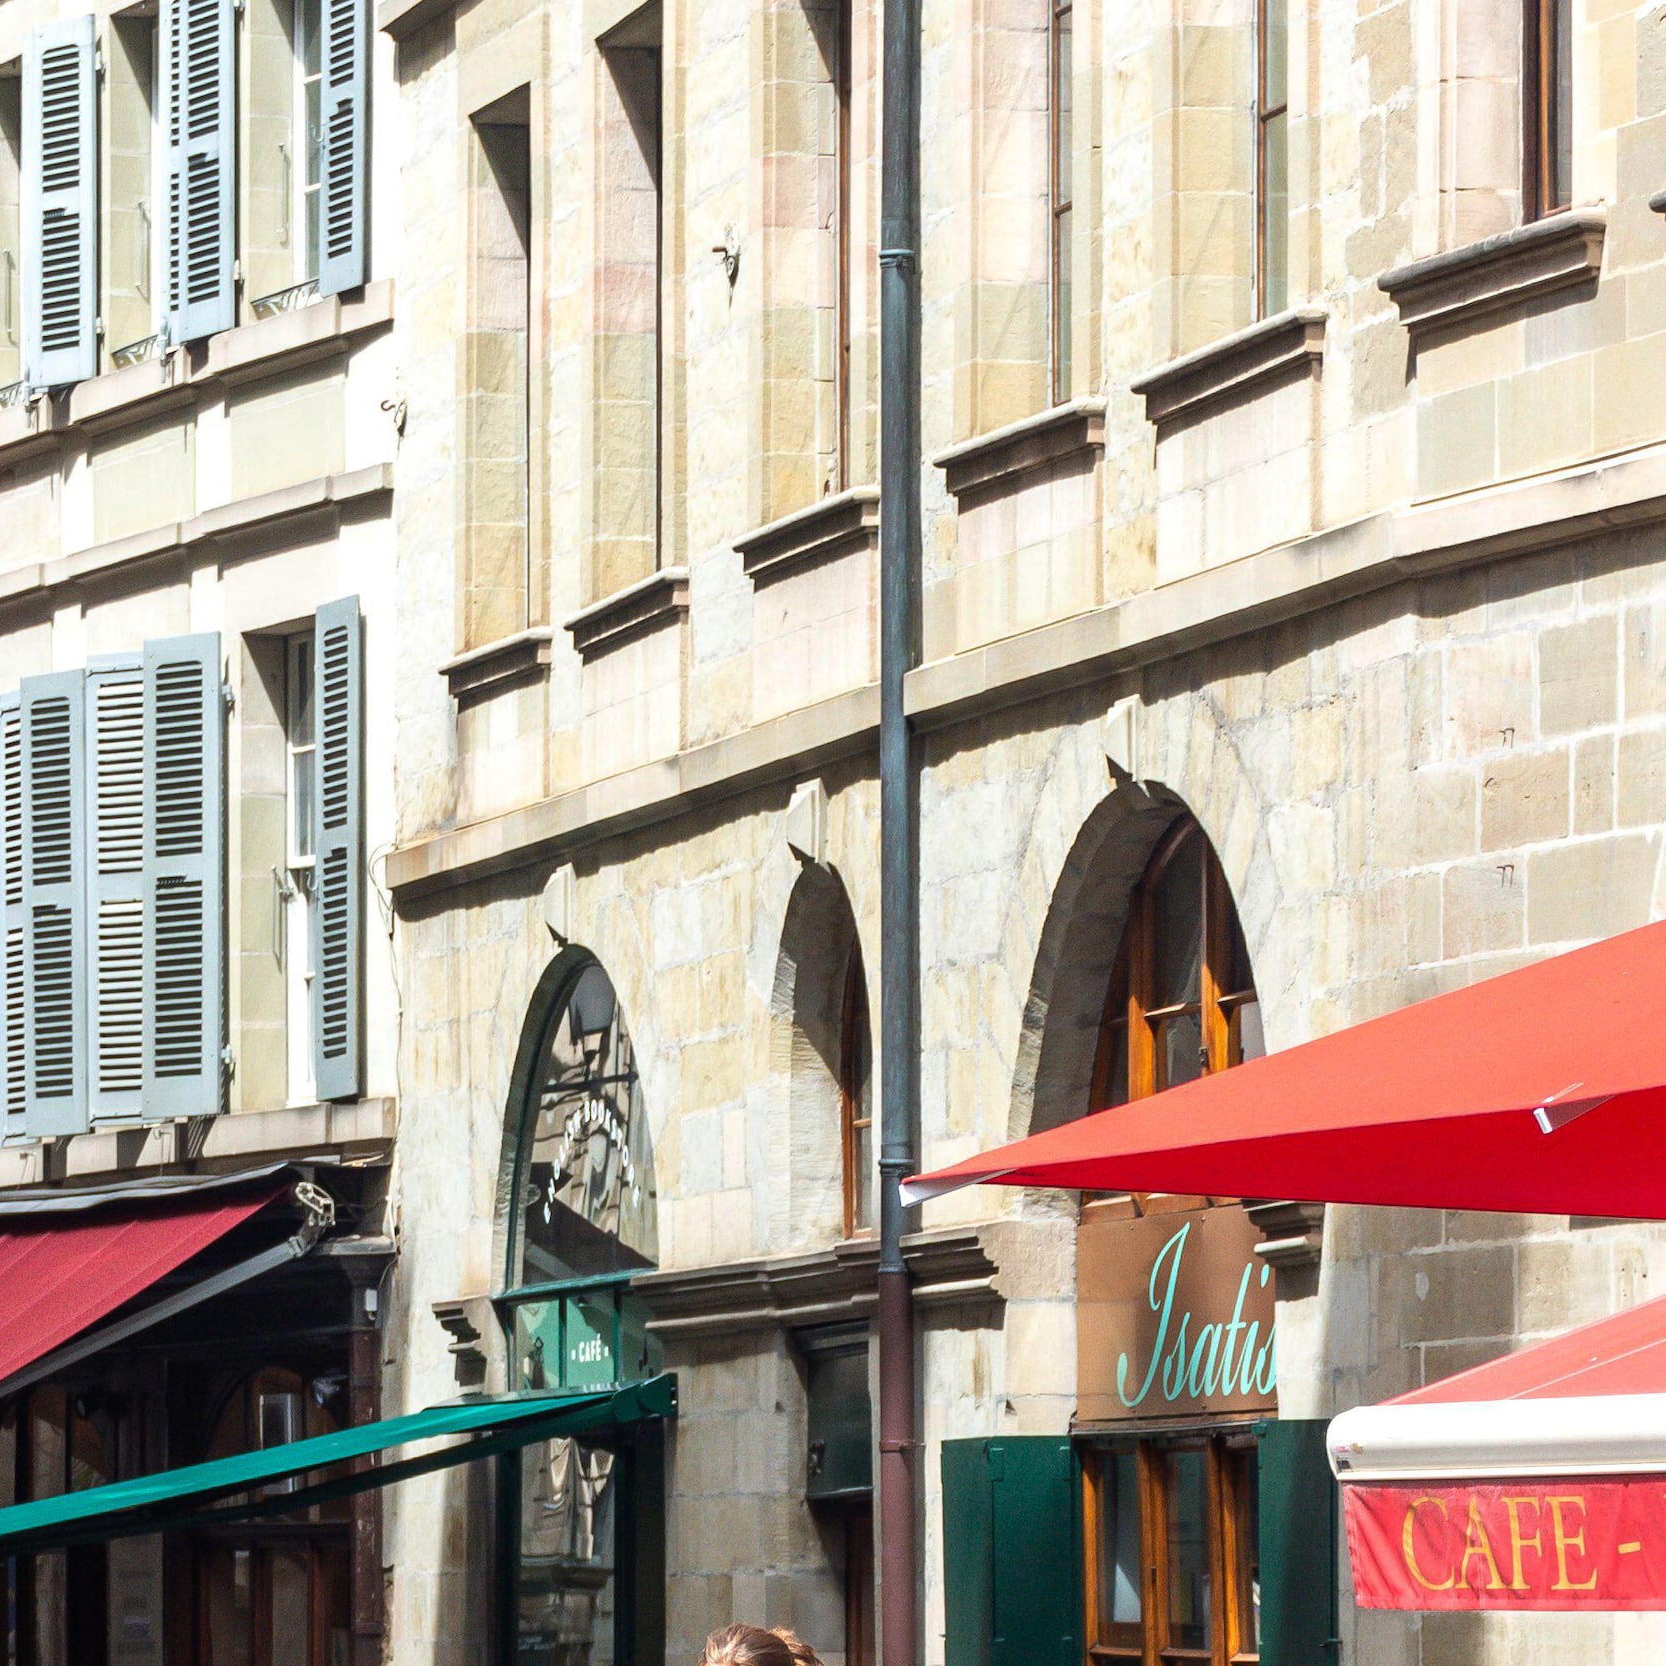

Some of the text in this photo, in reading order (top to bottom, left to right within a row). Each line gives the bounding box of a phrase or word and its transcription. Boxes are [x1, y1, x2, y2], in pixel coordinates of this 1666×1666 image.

[578, 1332, 602, 1363] CAFÉ
[1116, 1221, 1277, 1408] Isatis
[1401, 1495, 1597, 1591] CAFE
